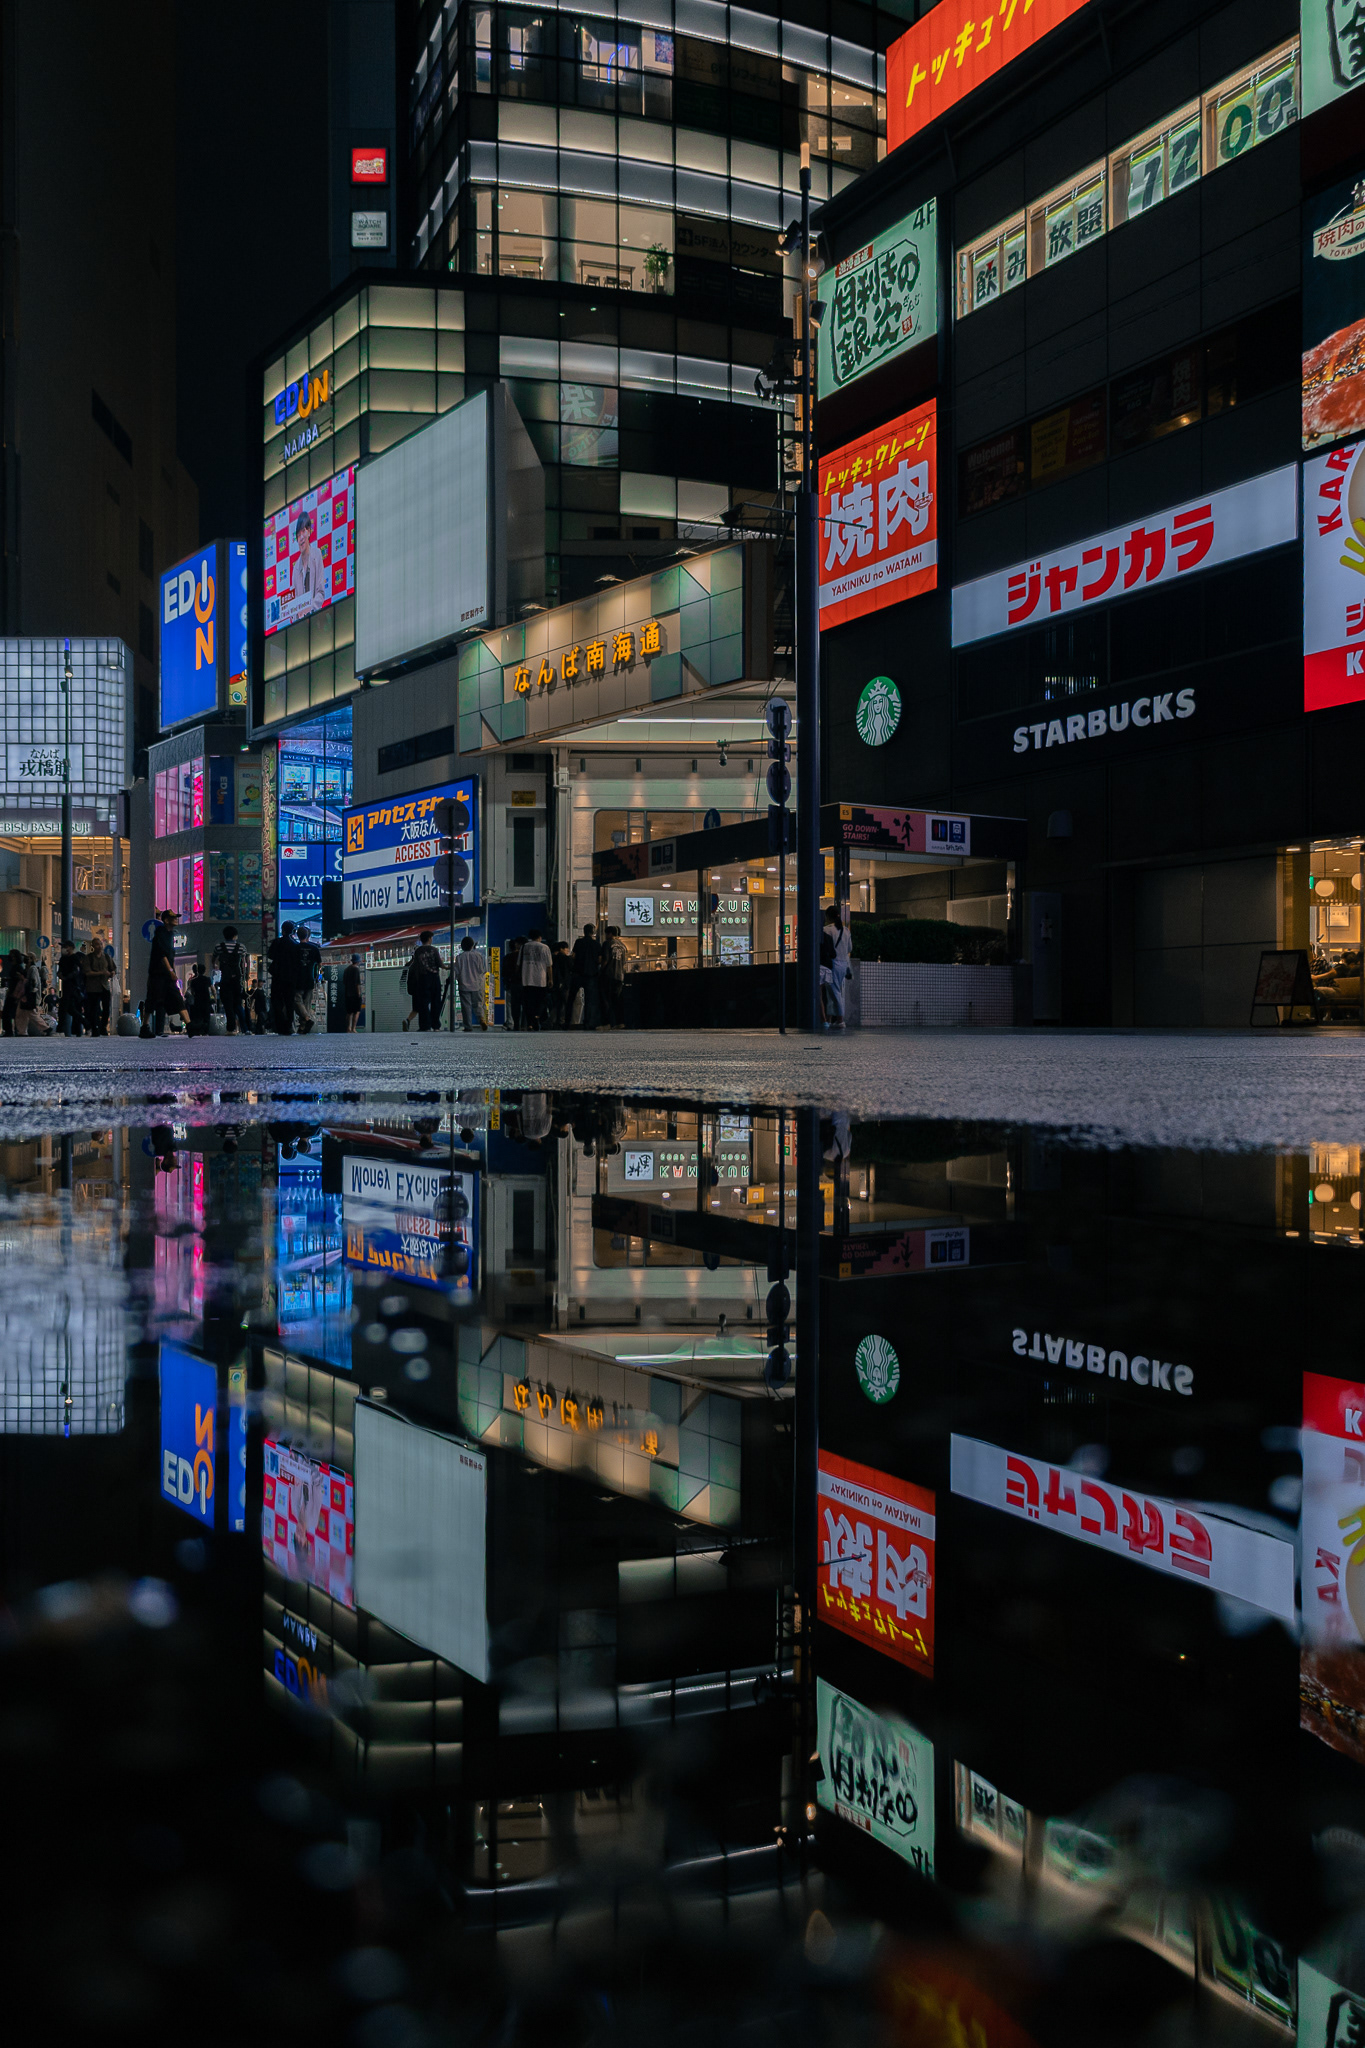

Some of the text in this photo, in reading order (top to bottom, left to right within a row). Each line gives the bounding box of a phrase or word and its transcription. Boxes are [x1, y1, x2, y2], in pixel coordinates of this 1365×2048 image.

[913, 202, 935, 230] 4F
[1318, 218, 1364, 251] 焼肉の
[836, 251, 920, 329] 目利きの
[837, 298, 903, 380] 銀次
[275, 369, 329, 425] EDION
[284, 423, 318, 460] NAMBA
[824, 421, 930, 497] トッキュウレーン
[824, 459, 929, 571] 焼肉
[831, 552, 923, 597] YAKINIKU no WATAMI
[1008, 503, 1214, 625] ジャンカラ
[514, 621, 661, 693] なんば南海通
[1013, 688, 1196, 754] STARBUCKS
[30, 748, 60, 760] なんば
[842, 824, 880, 833] GO DOWN-
[843, 832, 869, 841] STAIRS!
[395, 841, 431, 863] ACCESS
[352, 873, 439, 911] Money EXcha
